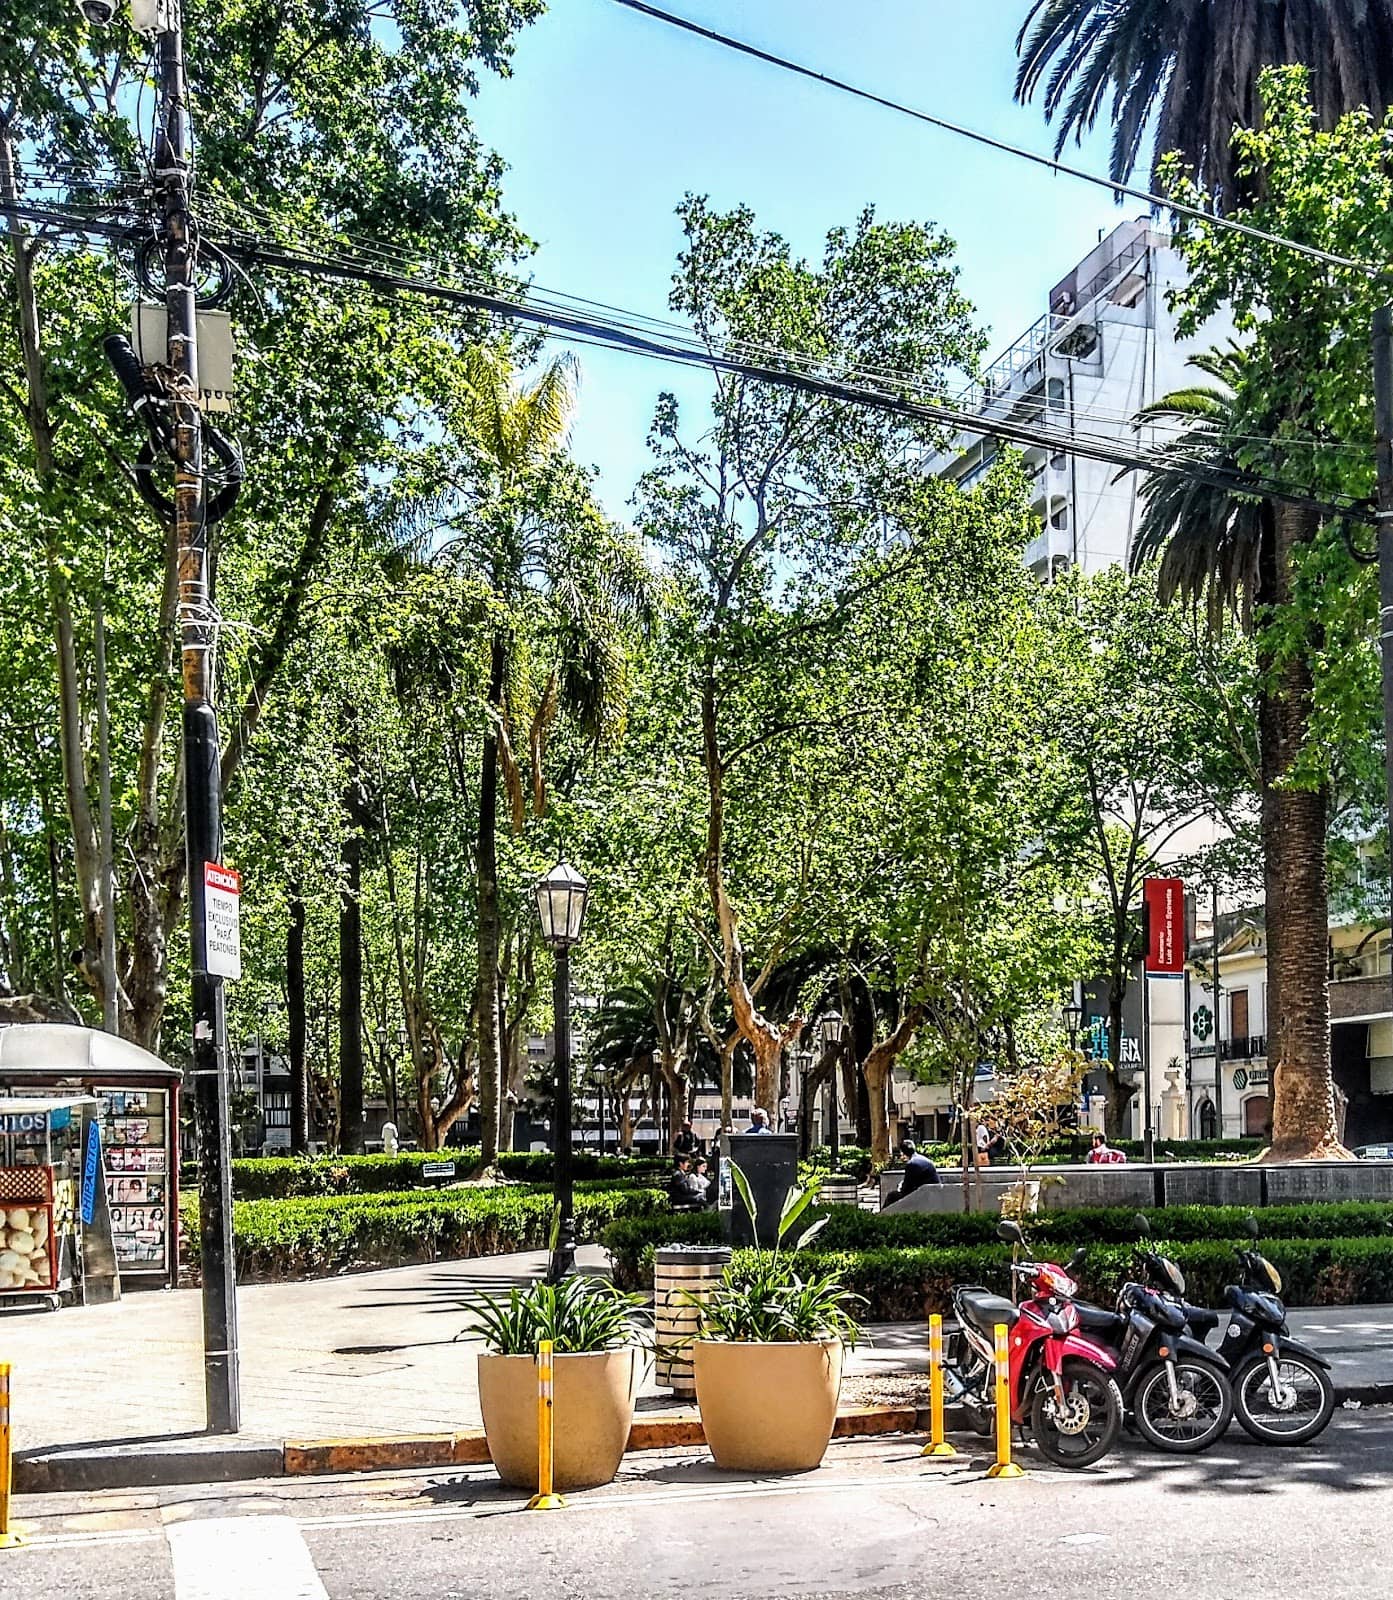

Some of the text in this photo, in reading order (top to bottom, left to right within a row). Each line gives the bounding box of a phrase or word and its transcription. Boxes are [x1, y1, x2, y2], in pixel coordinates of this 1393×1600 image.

[213, 898, 233, 913] TIEMPO
[1165, 888, 1173, 920] Spinetta
[208, 911, 238, 929] EXCLUSIVO
[209, 940, 238, 956] PEATONES
[1120, 1038, 1139, 1051] EN
[82, 1125, 97, 1221] CHIPACITOS
